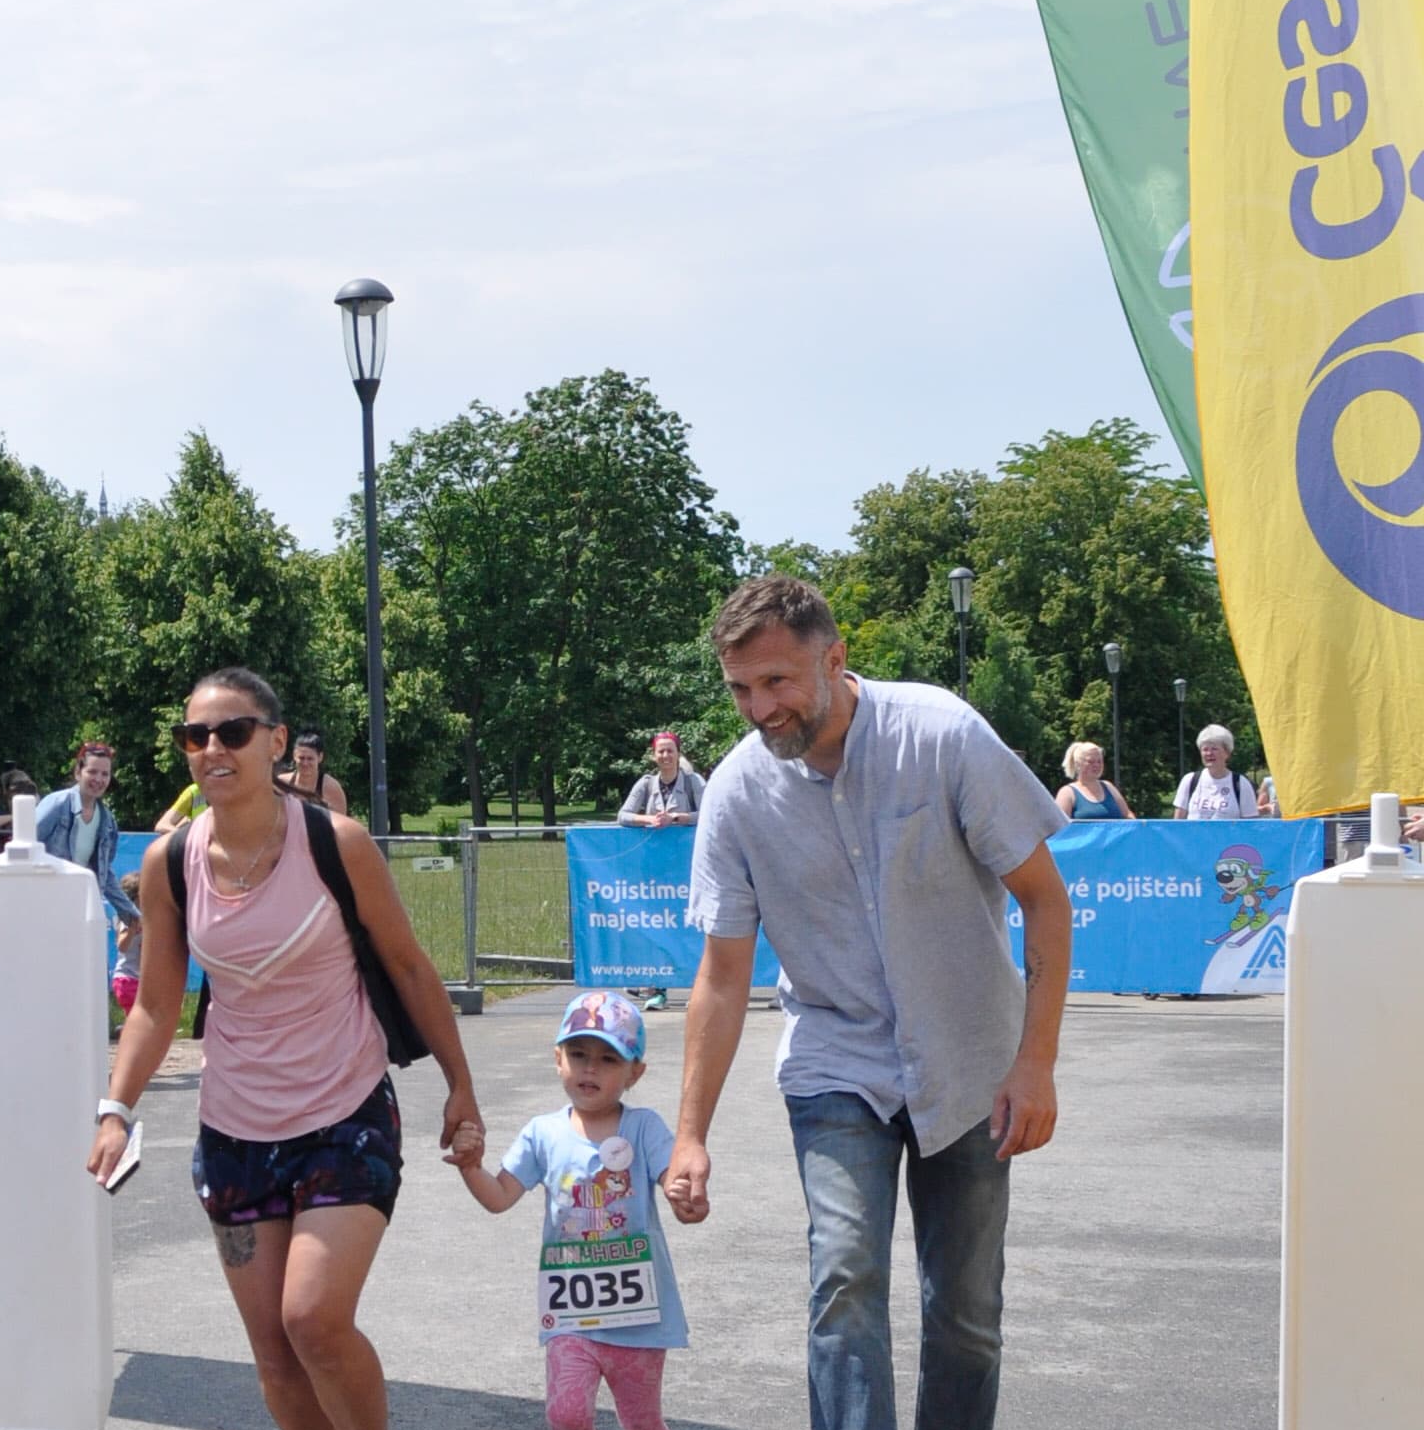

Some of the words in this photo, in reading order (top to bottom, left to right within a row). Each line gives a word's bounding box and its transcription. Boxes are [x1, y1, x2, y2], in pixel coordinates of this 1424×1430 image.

[586, 879, 689, 904] Pojistíme
[1096, 876, 1203, 903] pojištění
[589, 907, 678, 932] majetek
[590, 965, 675, 978] www.pvzp.cz
[591, 1238, 647, 1263] HELP
[548, 1268, 645, 1310] 2035
